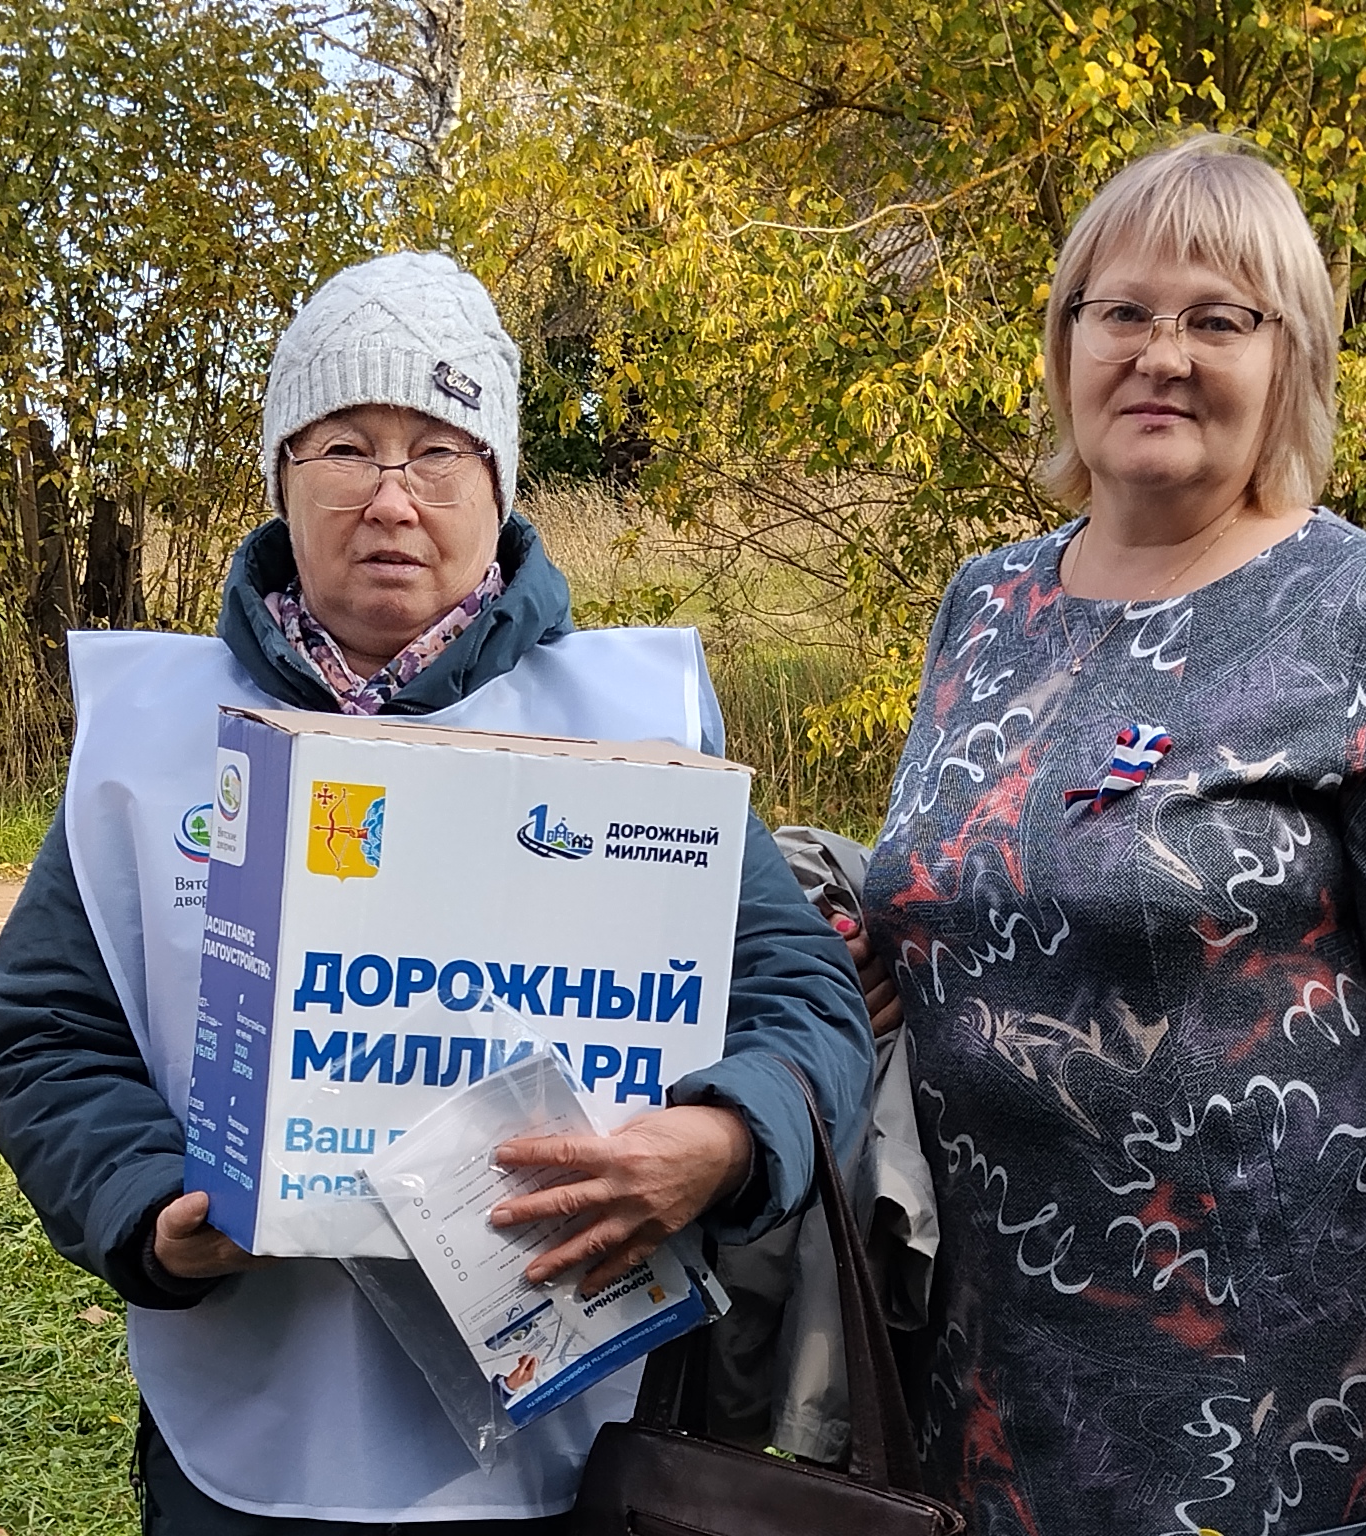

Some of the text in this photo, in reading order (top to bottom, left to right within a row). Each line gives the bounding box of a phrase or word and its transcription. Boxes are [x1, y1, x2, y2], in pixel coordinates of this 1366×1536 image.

[606, 822, 719, 846] ДОРОЖНЫЙ
[604, 844, 709, 868] МИЛЛИАРД
[202, 938, 271, 980] ЛАГОУСТРОЙСТВО:
[292, 951, 704, 1026] ДОРОЖНЫЙ
[284, 1116, 376, 1155] Ваш
[582, 1269, 656, 1319] ДОРОЖНЫЙ
